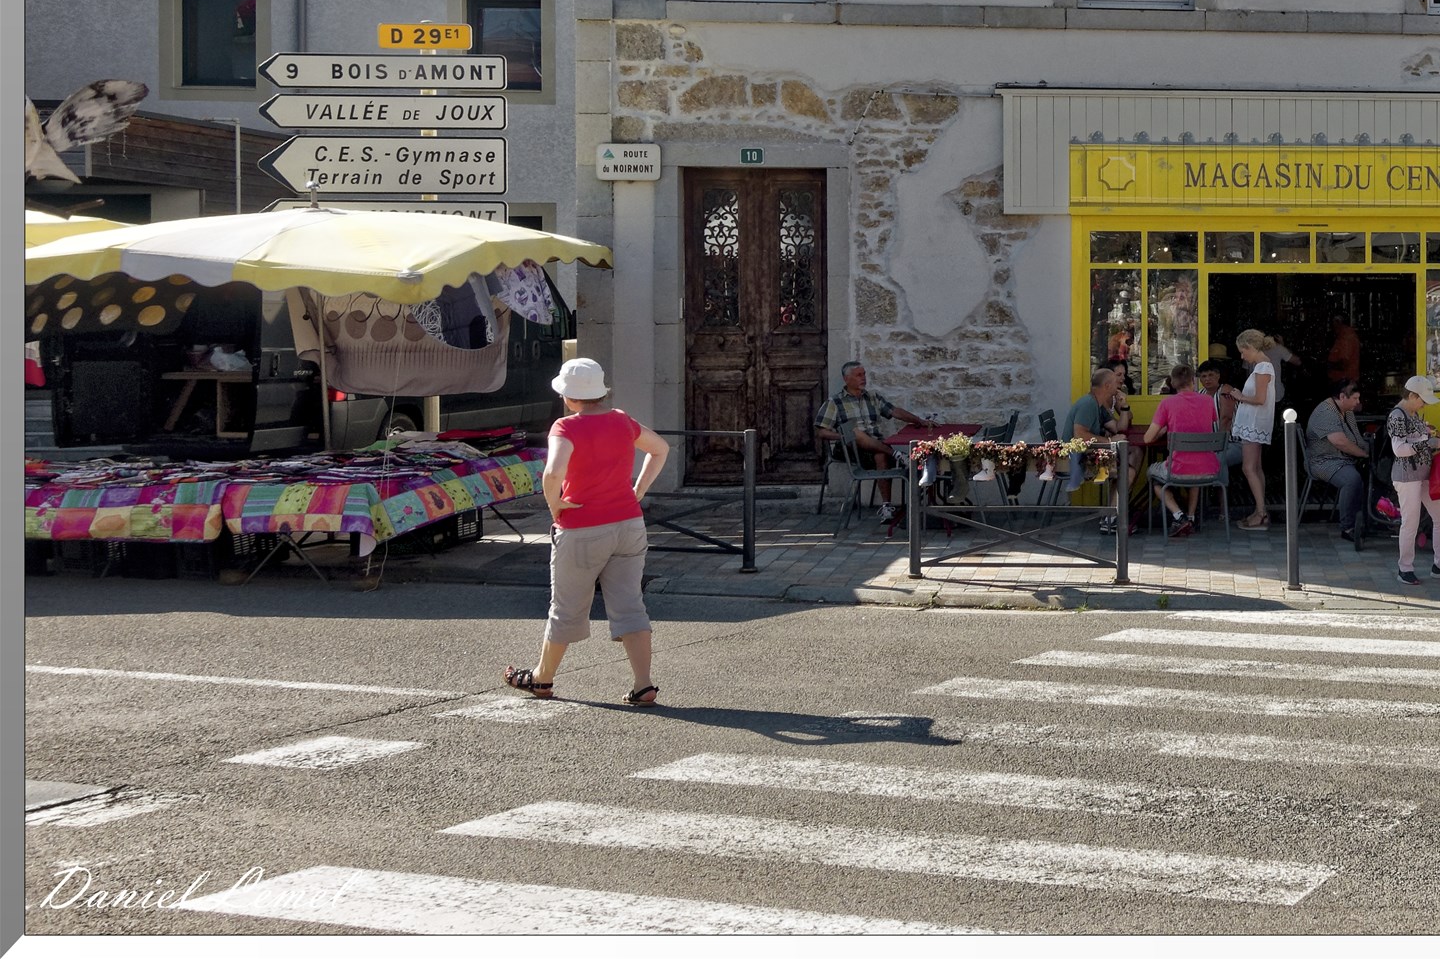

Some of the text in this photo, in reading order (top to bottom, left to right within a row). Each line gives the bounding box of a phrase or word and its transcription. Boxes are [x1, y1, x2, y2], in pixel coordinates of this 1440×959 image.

[390, 28, 403, 44] D
[286, 63, 299, 80] 9
[331, 63, 389, 80] BOIS
[305, 101, 496, 121] VALLÉE DE JOUX
[623, 150, 649, 159] ROUTE
[746, 150, 758, 162] 10
[602, 164, 654, 174] du NOIRMONT
[1184, 161, 1324, 190] MAGASIN
[1334, 164, 1373, 192] DU
[307, 168, 496, 190] Terrain de Sport
